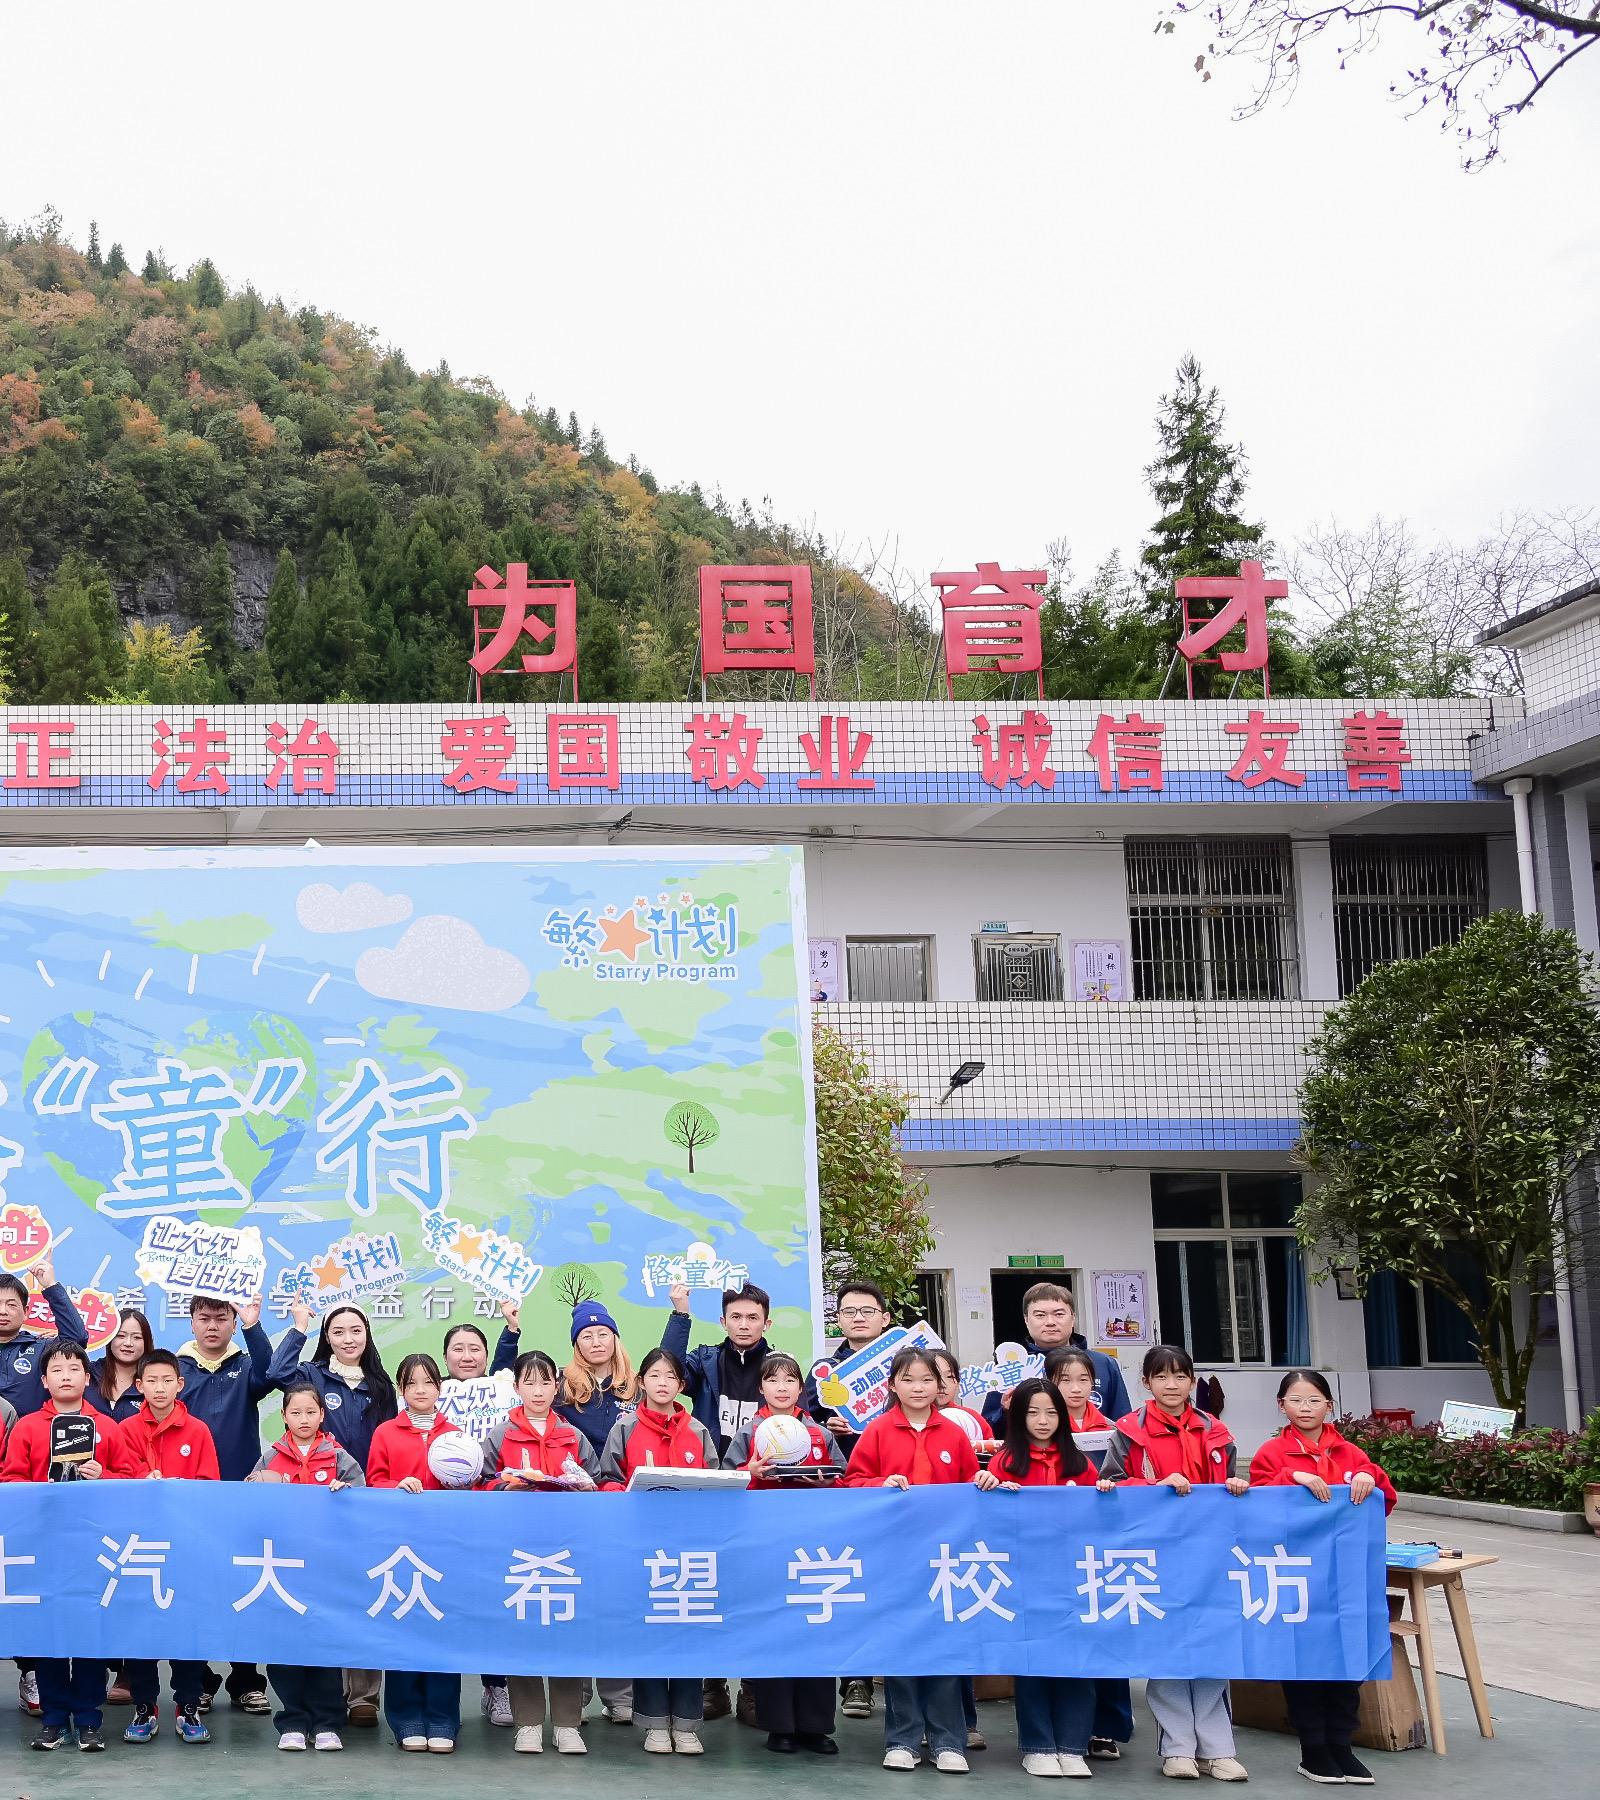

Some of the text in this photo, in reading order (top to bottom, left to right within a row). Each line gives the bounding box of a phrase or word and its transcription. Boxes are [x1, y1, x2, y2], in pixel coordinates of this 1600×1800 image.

[467, 561, 1288, 676] 为国育才
[148, 719, 340, 795] 法治
[440, 714, 620, 794] 爱国
[685, 712, 875, 791] 敬业
[972, 710, 1164, 791] 诚信
[1224, 710, 1411, 791] 友善
[596, 964, 736, 981] Starry Program
[820, 949, 829, 968] 努力
[319, 1272, 404, 1307] Starry Program
[439, 1254, 519, 1308] Starry Program
[438, 1384, 497, 1415] 大众
